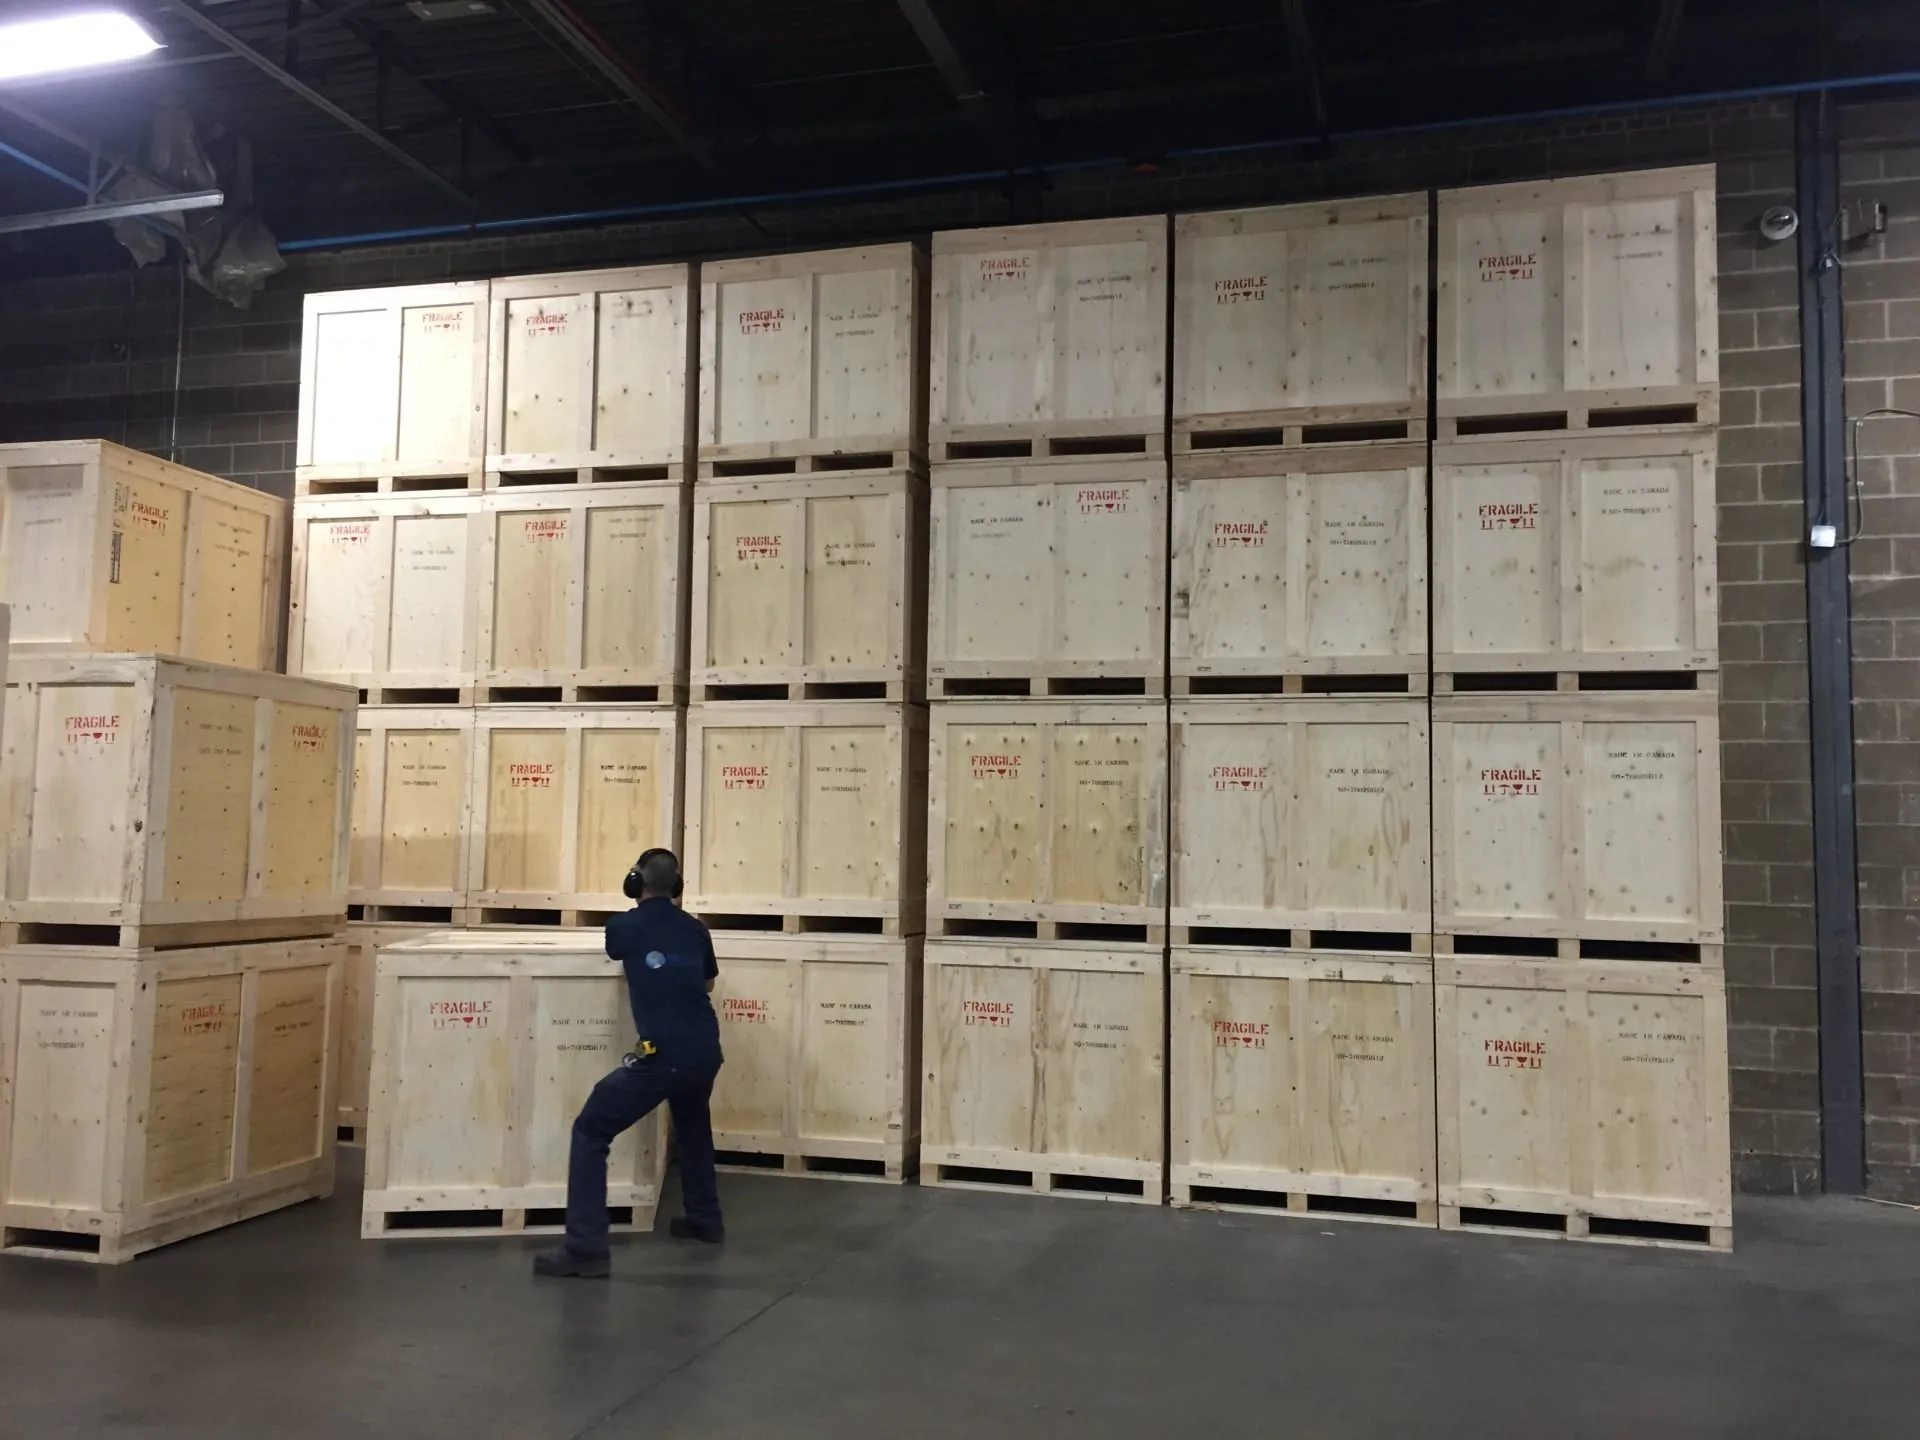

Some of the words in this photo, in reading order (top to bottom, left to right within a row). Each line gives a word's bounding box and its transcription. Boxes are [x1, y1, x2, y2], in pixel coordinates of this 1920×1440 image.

[980, 257, 1030, 270] FRAGILE
[1478, 254, 1536, 268] FRAGILE
[1215, 276, 1268, 291] FRAGILE
[526, 313, 568, 326] FRAGILE
[739, 308, 784, 323] FRAGILE
[1078, 489, 1130, 502] FRAGILE
[131, 502, 169, 520] FRAGILE
[1479, 504, 1538, 516] FRAGILE
[330, 524, 370, 536] FRAGILE
[525, 520, 566, 532] FRAGILE
[1214, 523, 1268, 535] FRAGILE
[736, 535, 782, 548] FRAGILE
[65, 715, 120, 729] FRAGILE
[292, 724, 328, 739] FRAGILE
[972, 756, 1022, 766] FRAGILE
[510, 764, 552, 774] FRAGILE
[722, 766, 768, 777] FRAGILE
[1212, 766, 1268, 778] FRAGILE
[1480, 769, 1542, 781] FRAGILE
[430, 1000, 492, 1014] FRAGILE
[722, 998, 768, 1011] FRAGILE
[963, 1001, 1014, 1014] FRAGILE
[182, 1004, 225, 1021] FRAGILE
[1213, 1021, 1270, 1036] FRAGILE
[1484, 1040, 1546, 1054] FRAGILE
